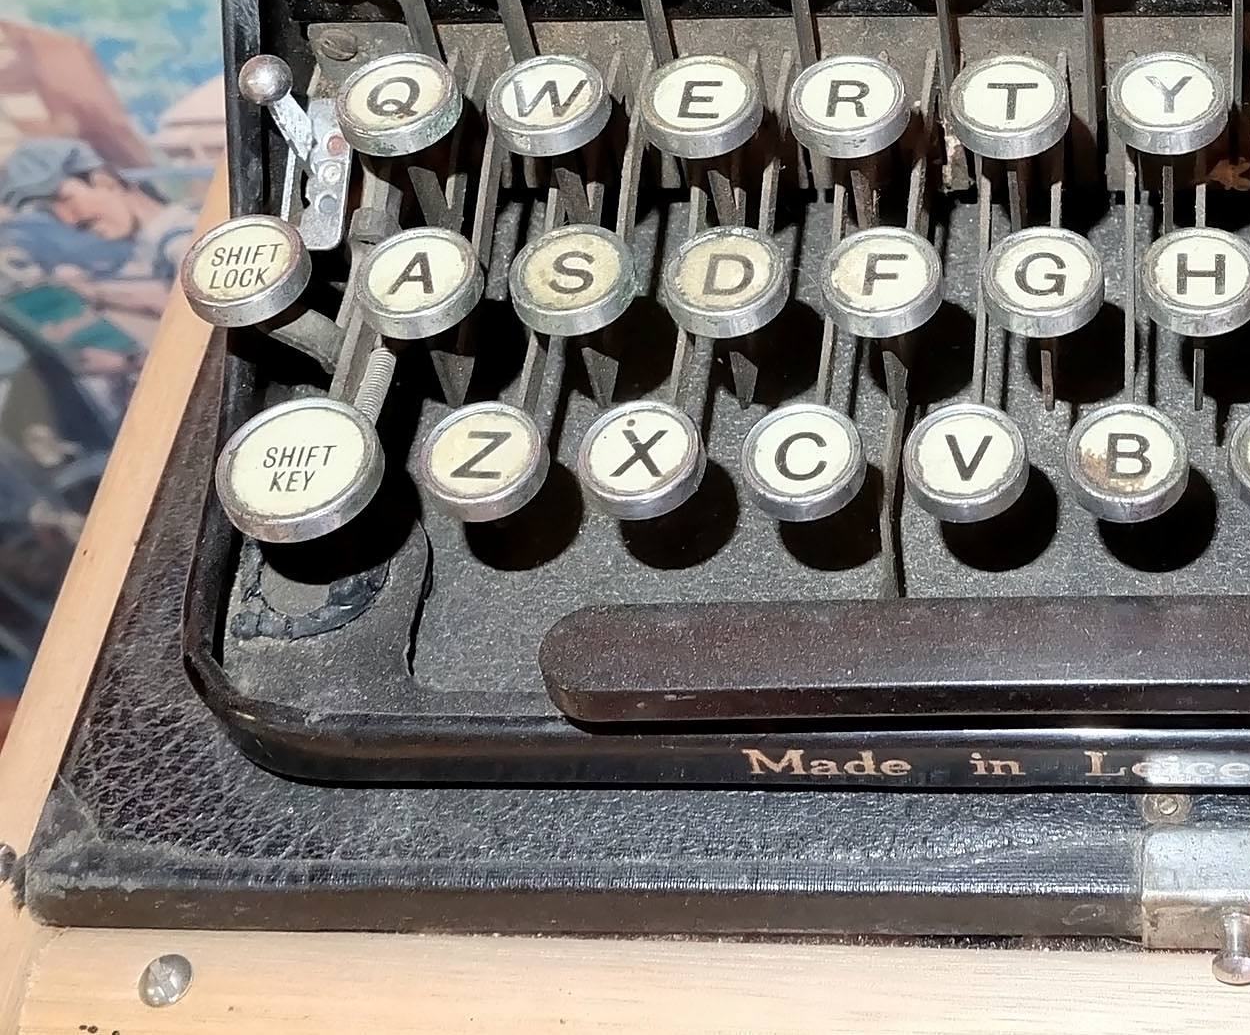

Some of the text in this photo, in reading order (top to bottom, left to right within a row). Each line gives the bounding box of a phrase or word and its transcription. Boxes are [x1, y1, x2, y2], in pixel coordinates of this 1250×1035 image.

[367, 76, 420, 118] Q
[513, 79, 587, 118] W
[677, 80, 723, 118] E
[826, 80, 870, 118] R
[987, 83, 1038, 120] T
[1145, 76, 1192, 113] Y
[210, 243, 284, 266] SHIFT
[388, 252, 434, 295] A
[549, 251, 596, 294] S
[702, 253, 755, 295] D
[861, 253, 908, 296] F
[1014, 252, 1067, 297] G
[1176, 253, 1225, 295] H
[209, 268, 271, 289] LOCK
[263, 444, 337, 469] SHIFT
[450, 431, 511, 479] Z
[610, 429, 669, 478] X
[774, 432, 828, 482] C
[945, 434, 993, 482] V
[1106, 433, 1152, 480] B
[269, 470, 315, 493] KEY
[741, 749, 912, 776] Made
[969, 752, 1026, 776] in
